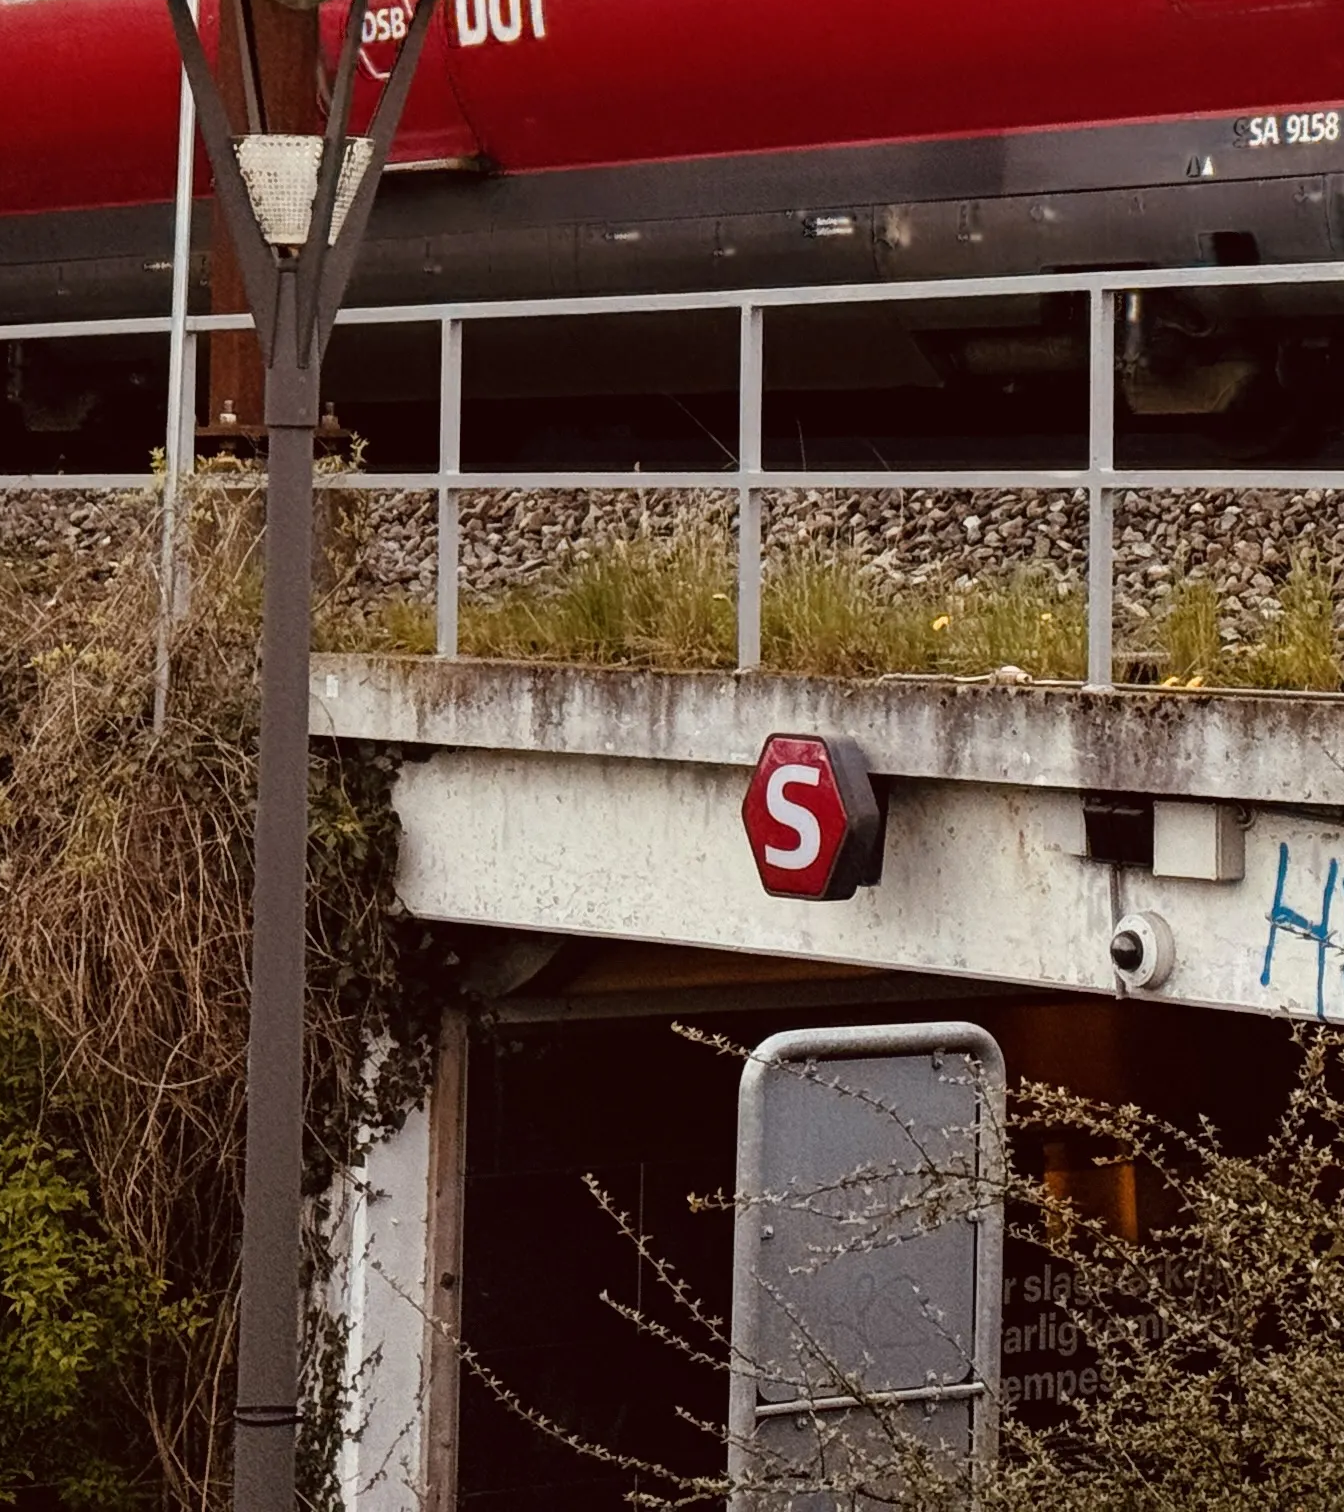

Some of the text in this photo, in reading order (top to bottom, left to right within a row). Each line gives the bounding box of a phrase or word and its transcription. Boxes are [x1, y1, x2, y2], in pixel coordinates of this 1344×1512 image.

[362, 6, 408, 44] DSB
[1249, 111, 1340, 146] SA 9158
[764, 763, 821, 870] S
[1001, 1312, 1078, 1357] arlig
